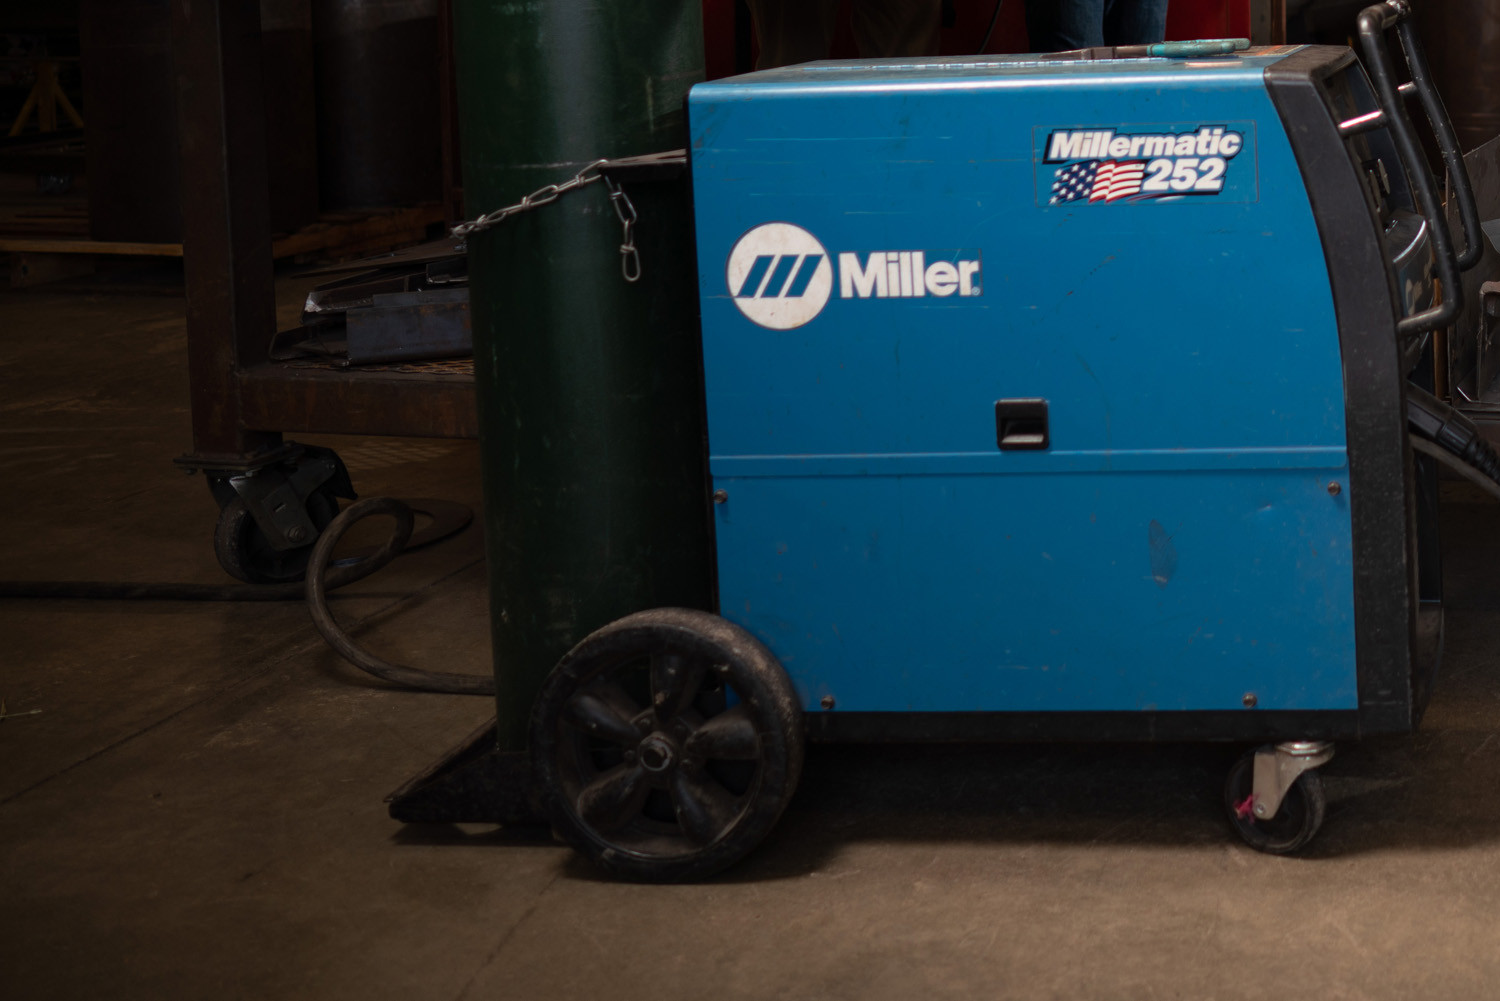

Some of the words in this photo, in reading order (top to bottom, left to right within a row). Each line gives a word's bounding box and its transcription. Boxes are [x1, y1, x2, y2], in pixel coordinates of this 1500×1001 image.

[1048, 127, 1241, 160] Millermatic
[1142, 157, 1226, 192] 252
[838, 250, 980, 299] Miller
